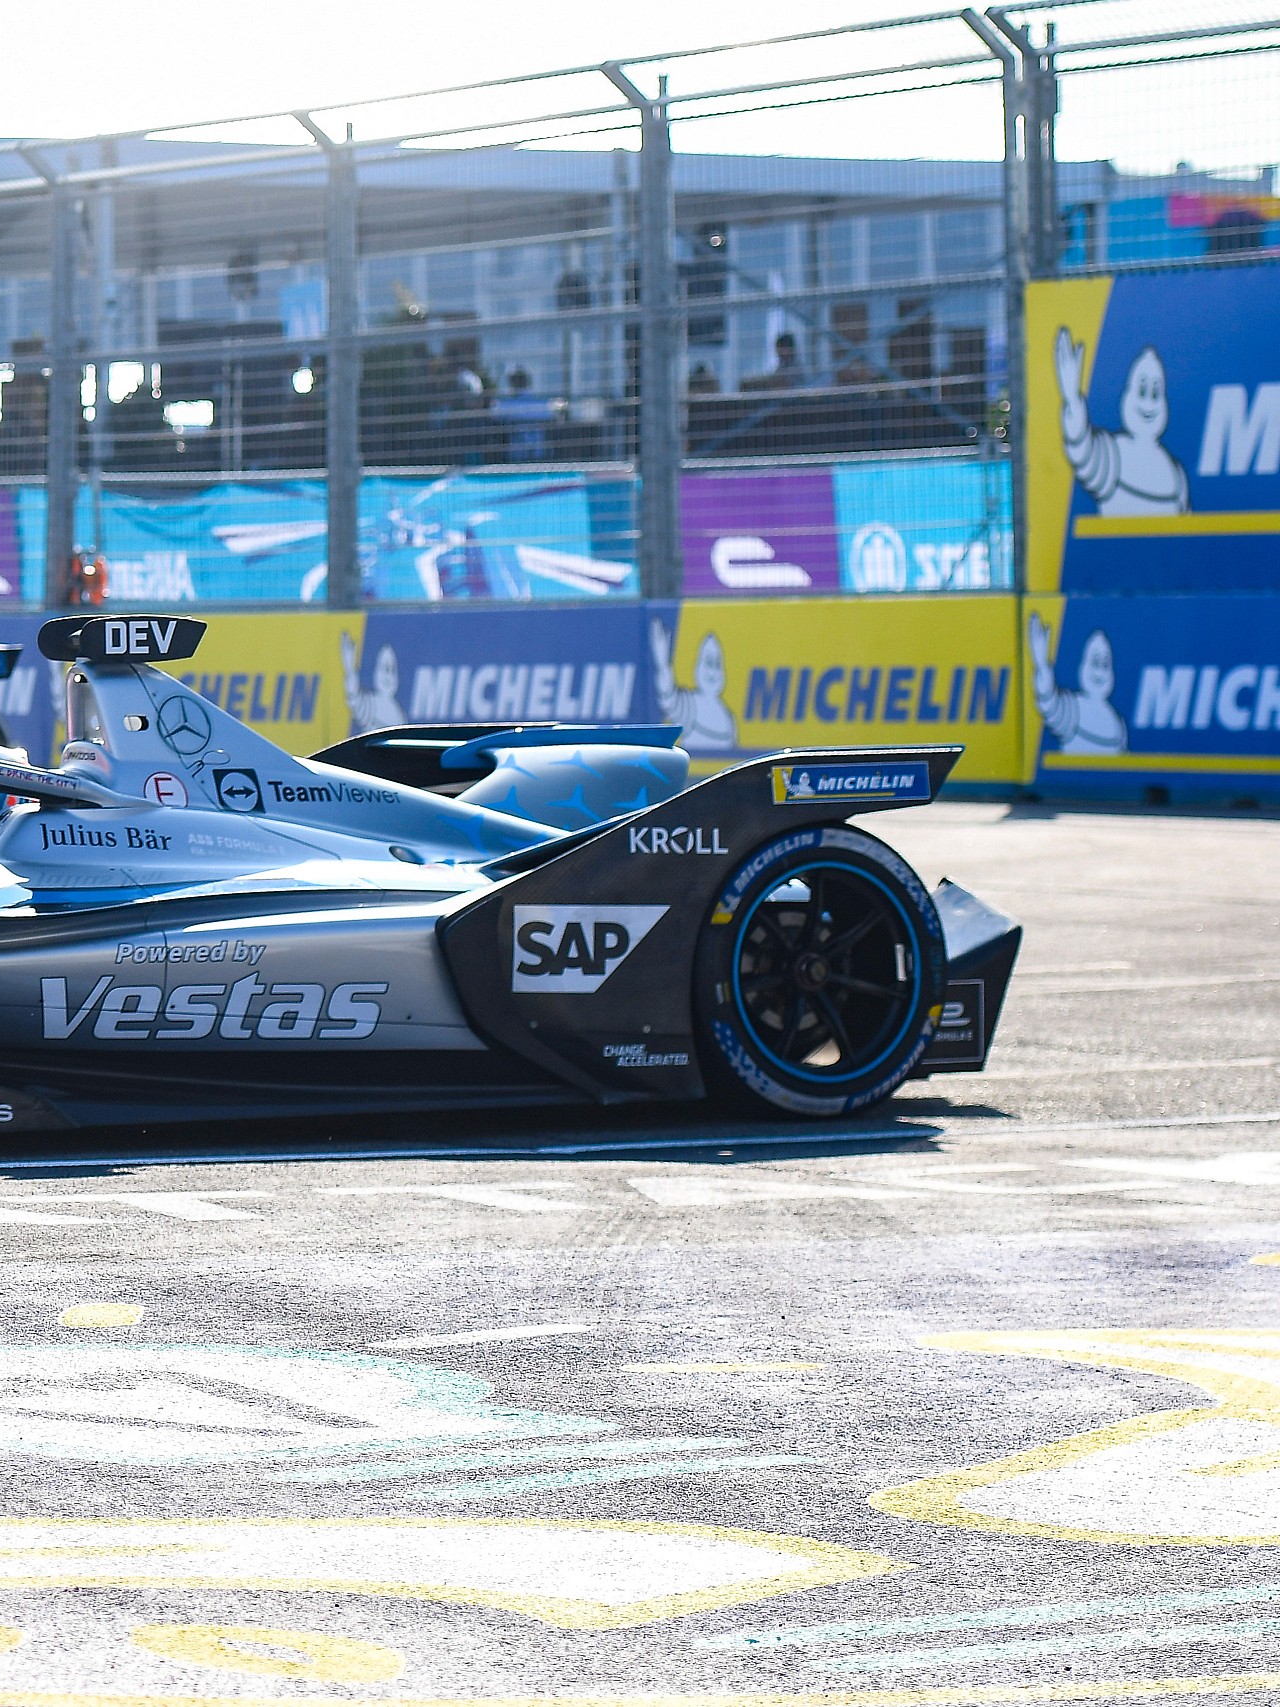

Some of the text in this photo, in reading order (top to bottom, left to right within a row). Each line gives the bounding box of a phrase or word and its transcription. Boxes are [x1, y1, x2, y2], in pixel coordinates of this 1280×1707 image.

[105, 620, 177, 655] DEV
[181, 671, 321, 725] HELIN
[411, 664, 637, 721] MICHELIN
[743, 665, 1013, 726] MICHELIN
[1133, 664, 1280, 731] MICH
[36, 774, 53, 785] THE
[267, 780, 402, 804] TeamViewer
[817, 774, 915, 791] MICHELIN
[40, 823, 172, 852] Julius Bär
[629, 826, 729, 855] KROLL
[734, 832, 815, 892] MICHELIN
[114, 940, 267, 967] Powered by
[517, 920, 631, 977] SAP
[40, 970, 389, 1041] Vestas
